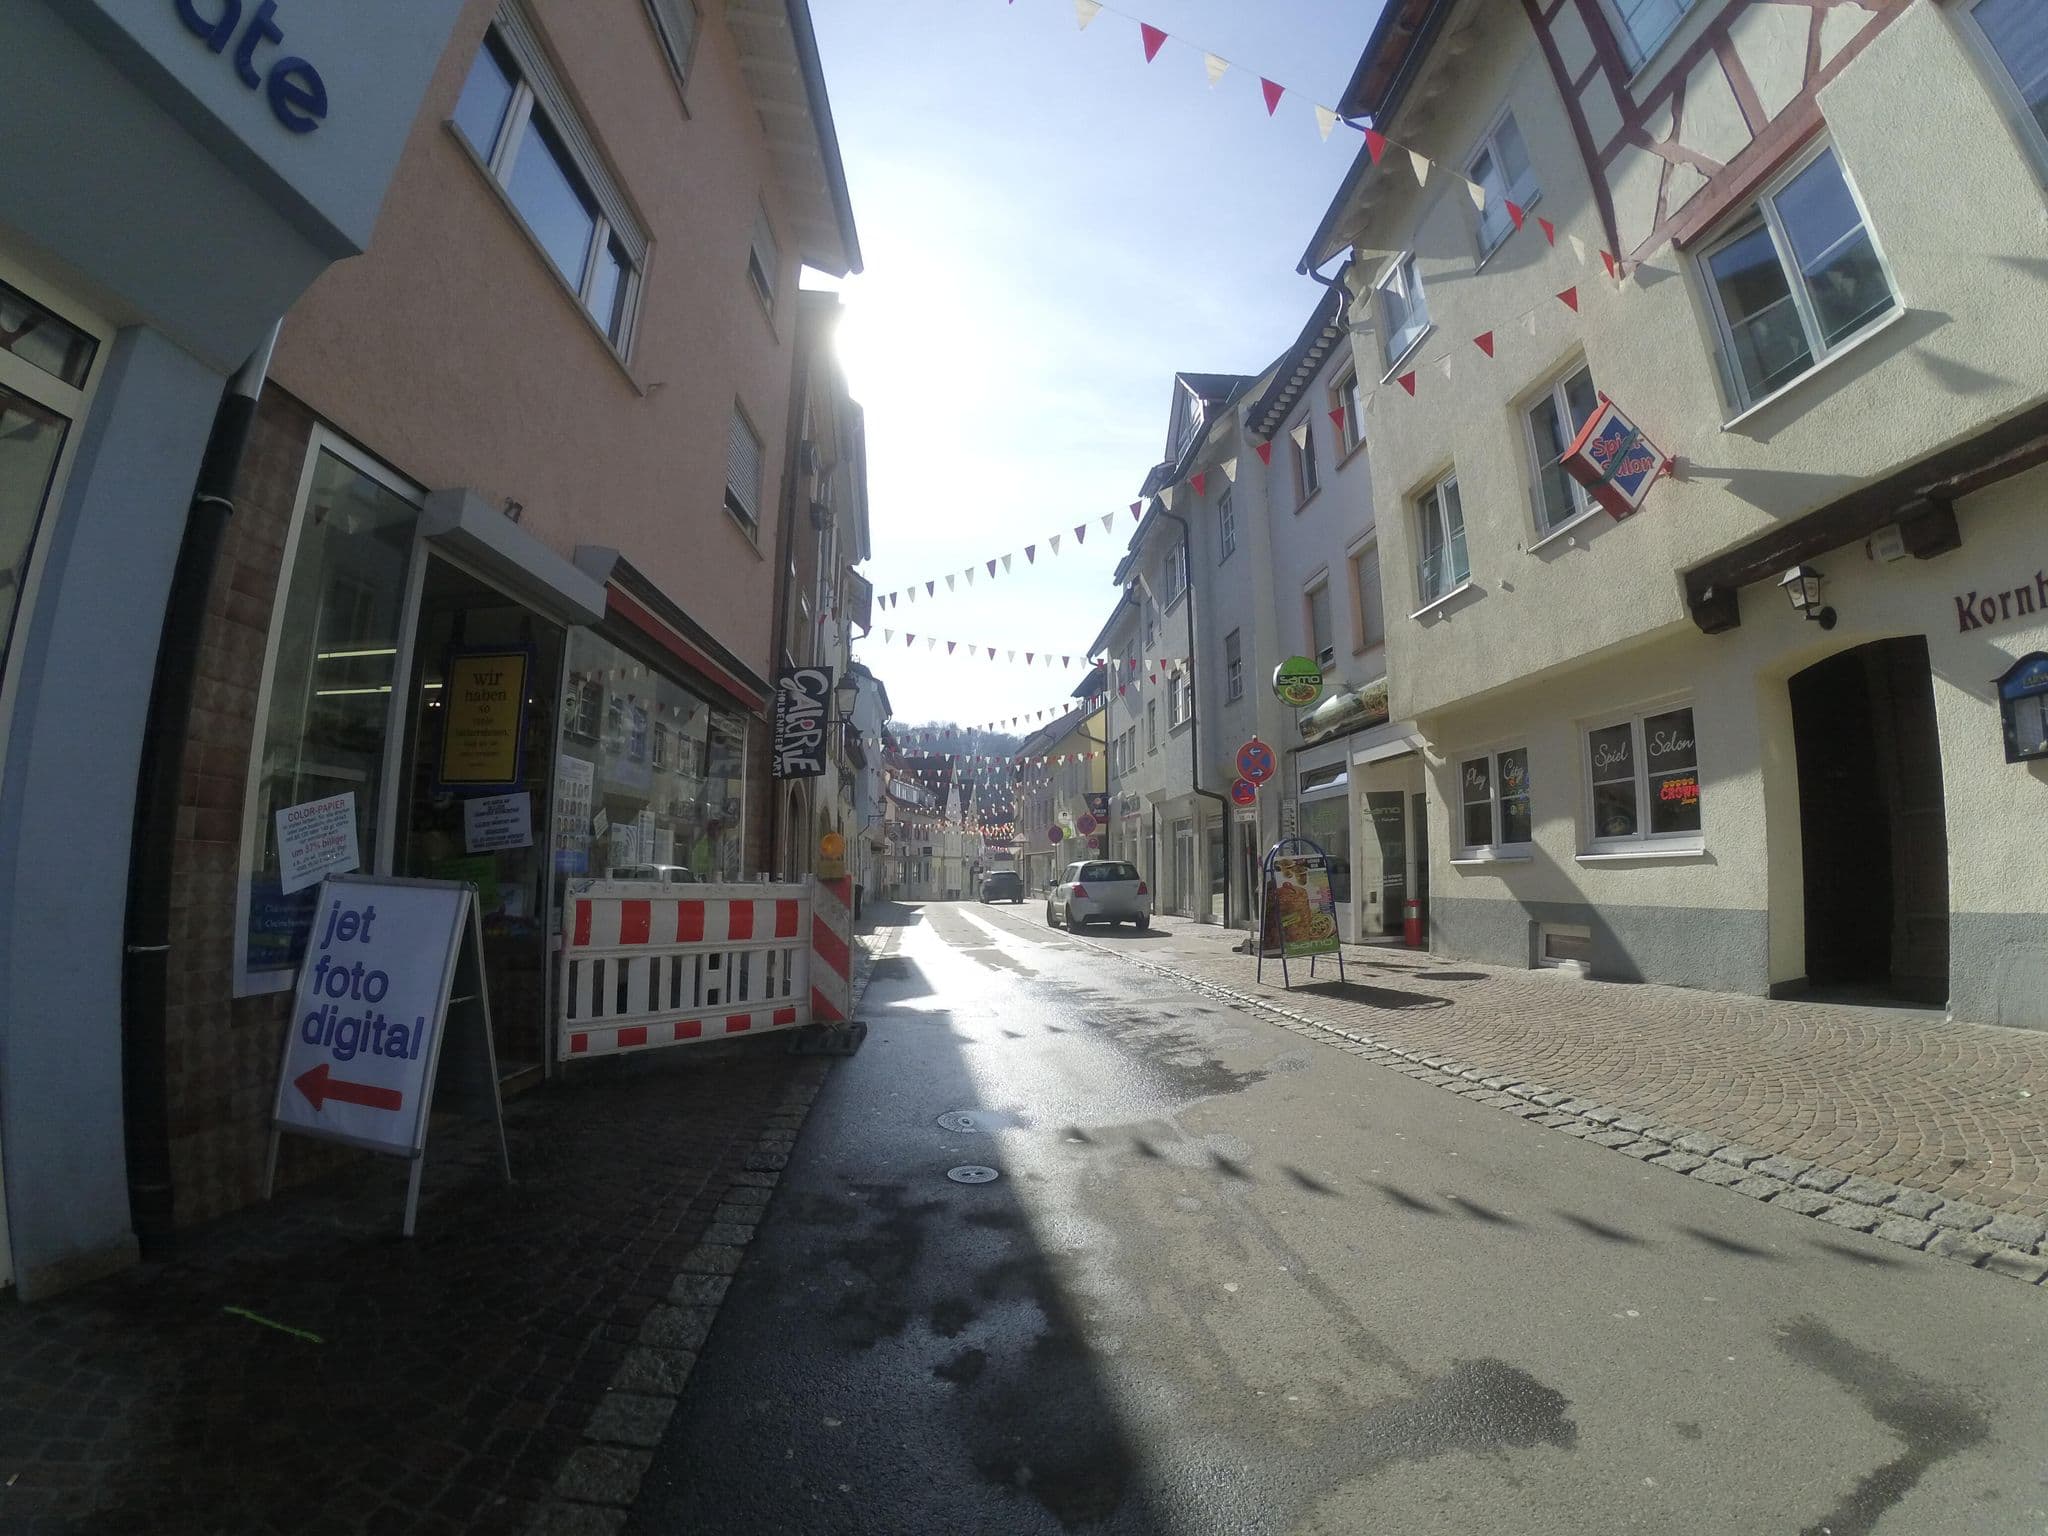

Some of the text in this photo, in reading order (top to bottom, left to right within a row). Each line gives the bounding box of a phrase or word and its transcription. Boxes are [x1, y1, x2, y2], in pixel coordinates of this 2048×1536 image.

[772, 755, 782, 779] ART
[1595, 730, 1694, 772] Spiel Salon
[320, 900, 376, 949] jet
[313, 955, 389, 1003] foto
[302, 1004, 425, 1061] digital
